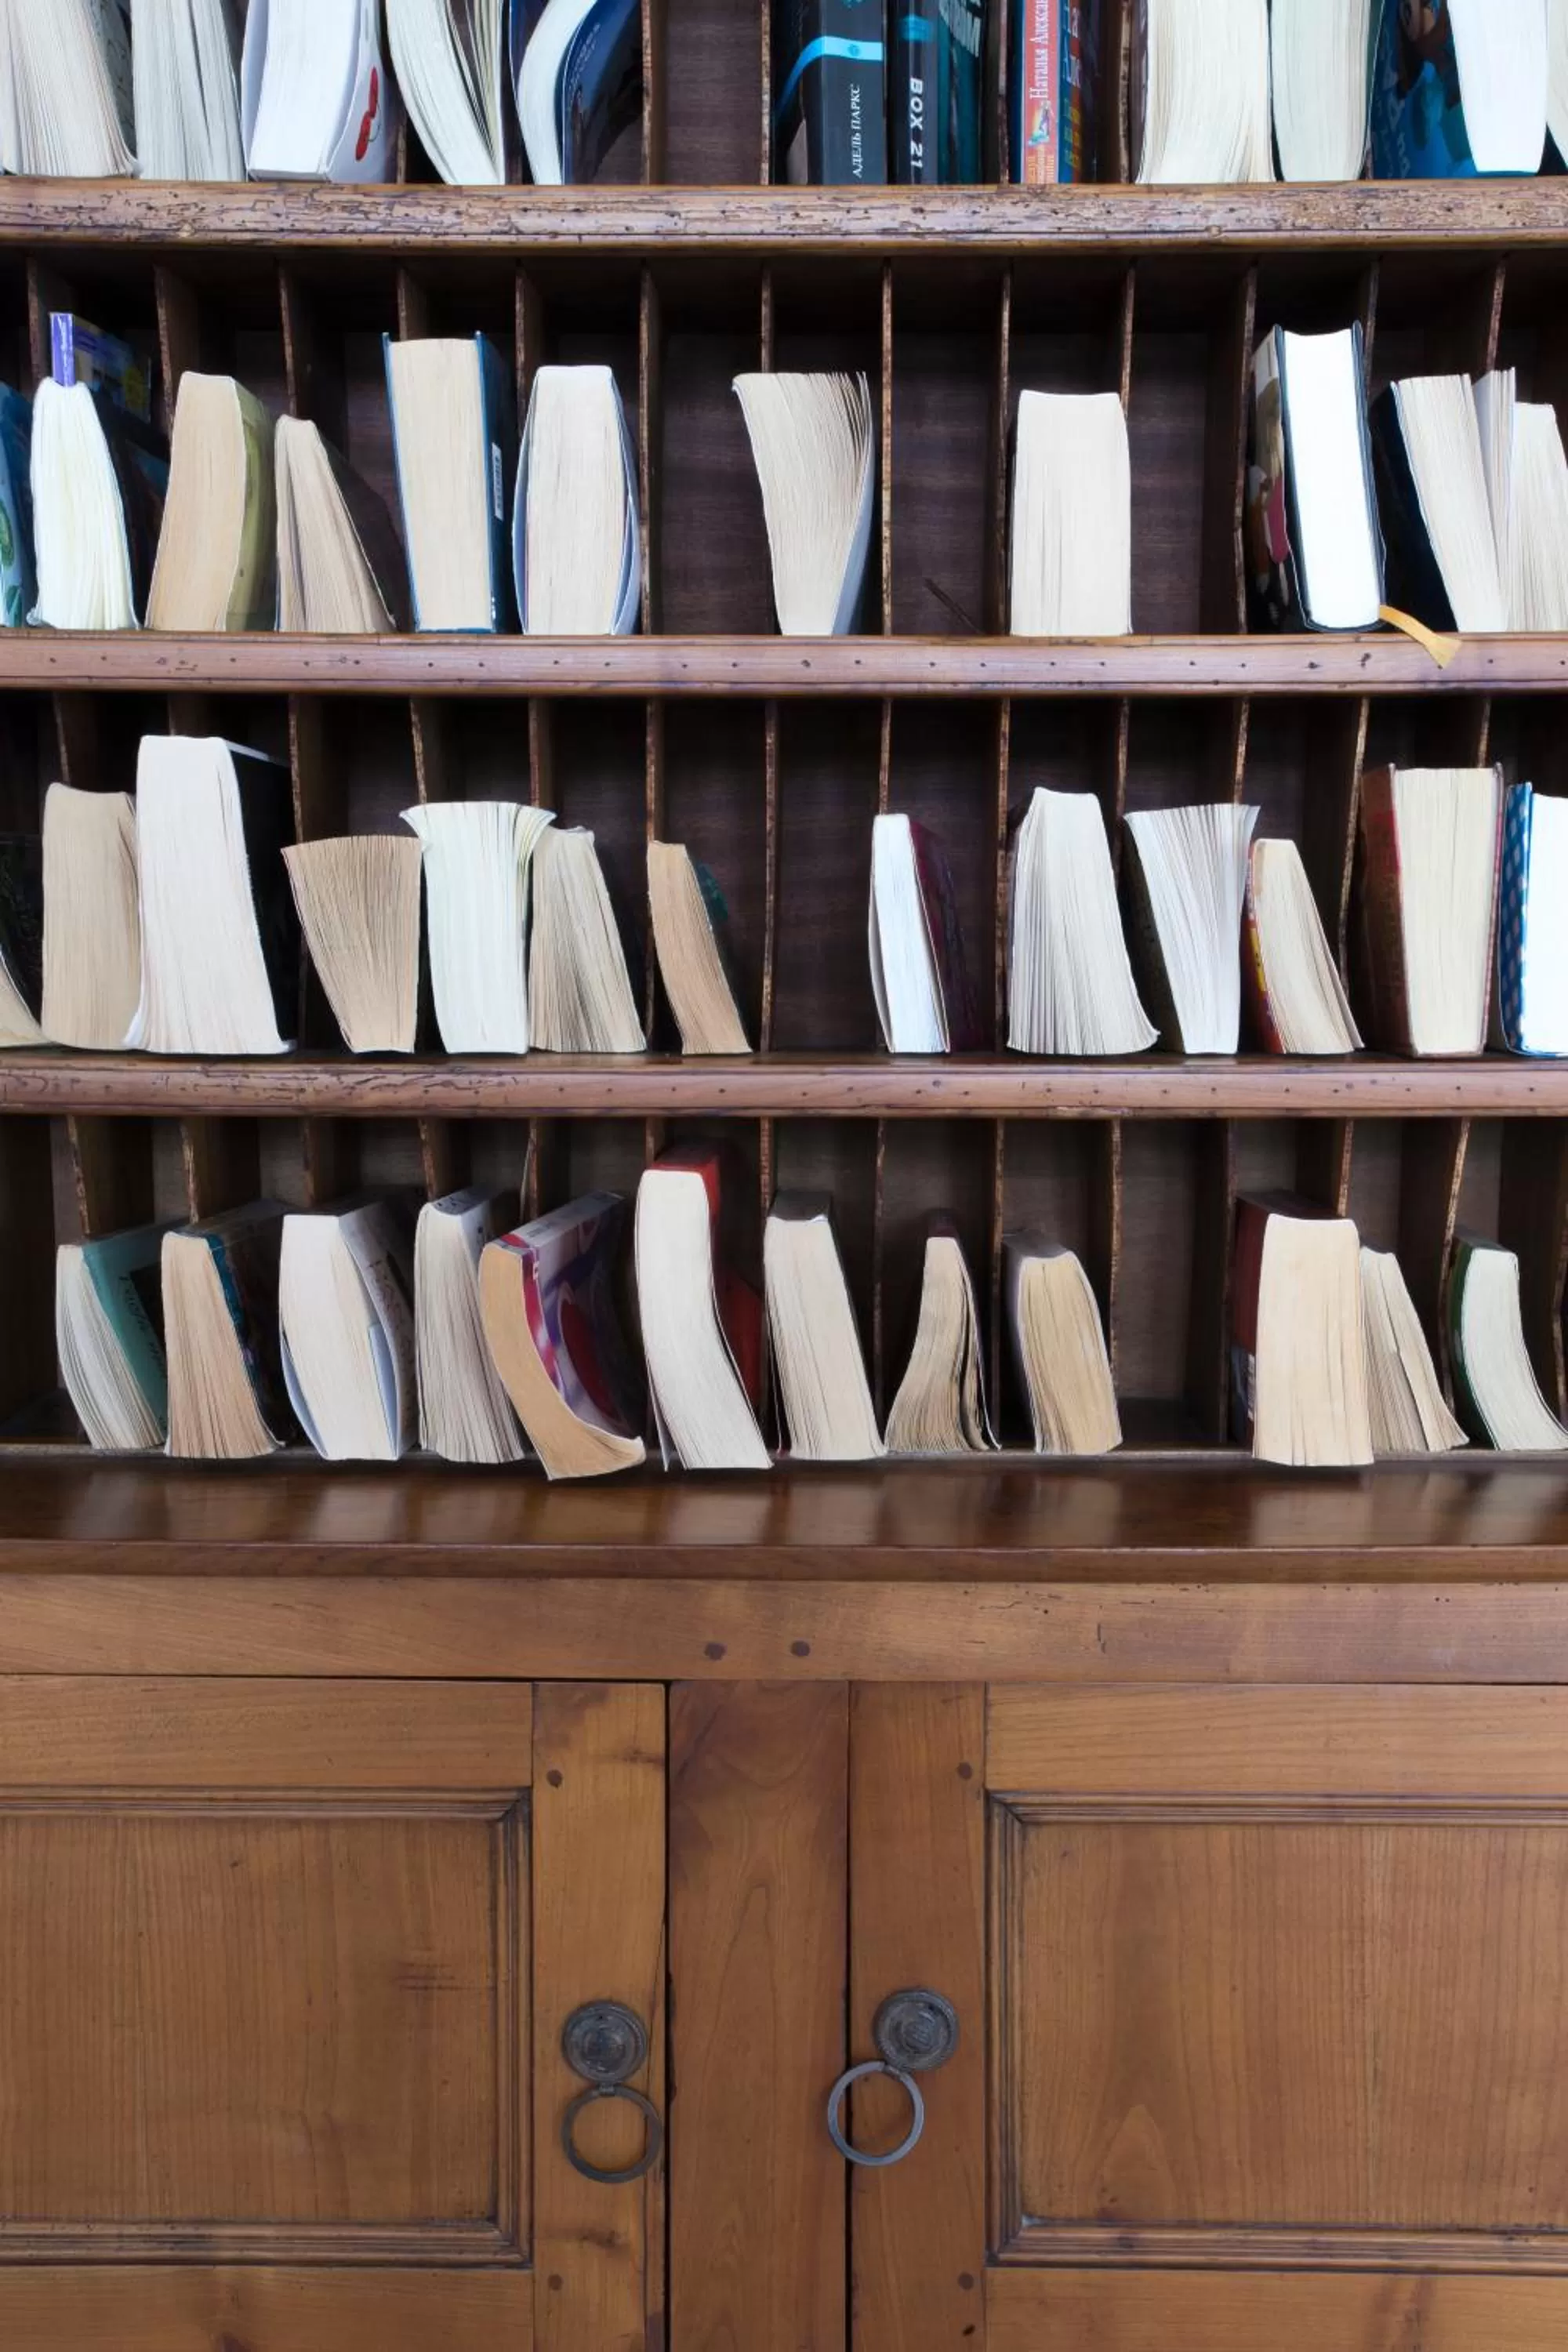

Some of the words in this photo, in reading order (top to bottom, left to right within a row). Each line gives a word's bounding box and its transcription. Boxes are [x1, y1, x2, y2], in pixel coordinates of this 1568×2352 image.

[1029, 49, 1048, 99] Наталья
[849, 84, 862, 129] ПАРКС
[909, 78, 924, 130] BOX
[851, 132, 863, 179] АДЕЛЬ
[909, 140, 924, 169] 21
